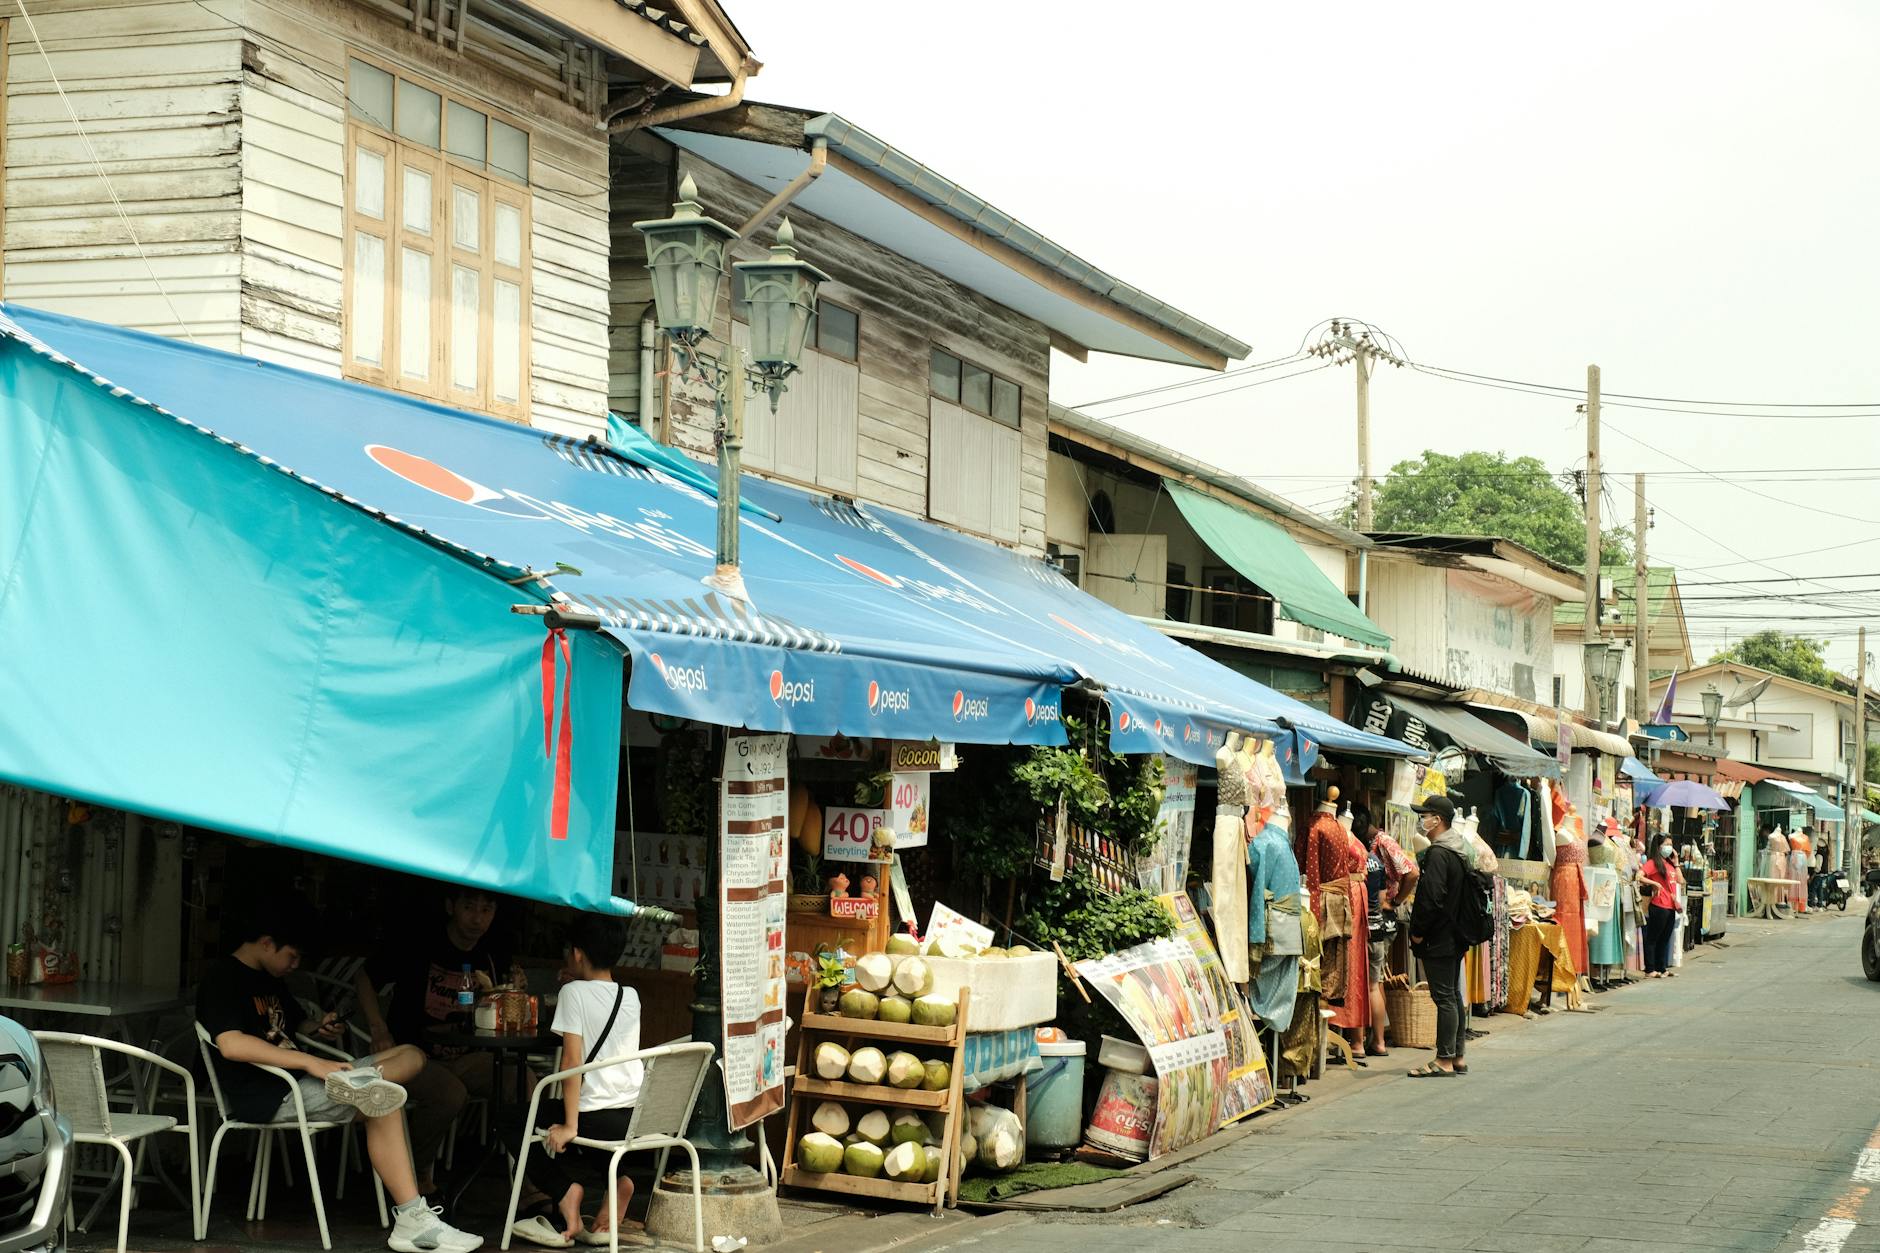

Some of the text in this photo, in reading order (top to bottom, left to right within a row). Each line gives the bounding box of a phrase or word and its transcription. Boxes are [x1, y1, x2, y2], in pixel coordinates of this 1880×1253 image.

[881, 688, 910, 713] pepsi
[964, 697, 989, 721] pepsi
[1035, 702, 1058, 726] pepsi
[1669, 730, 1677, 741] 9
[895, 783, 912, 809] 40
[828, 812, 869, 843] 40
[827, 845, 867, 859] Everyting
